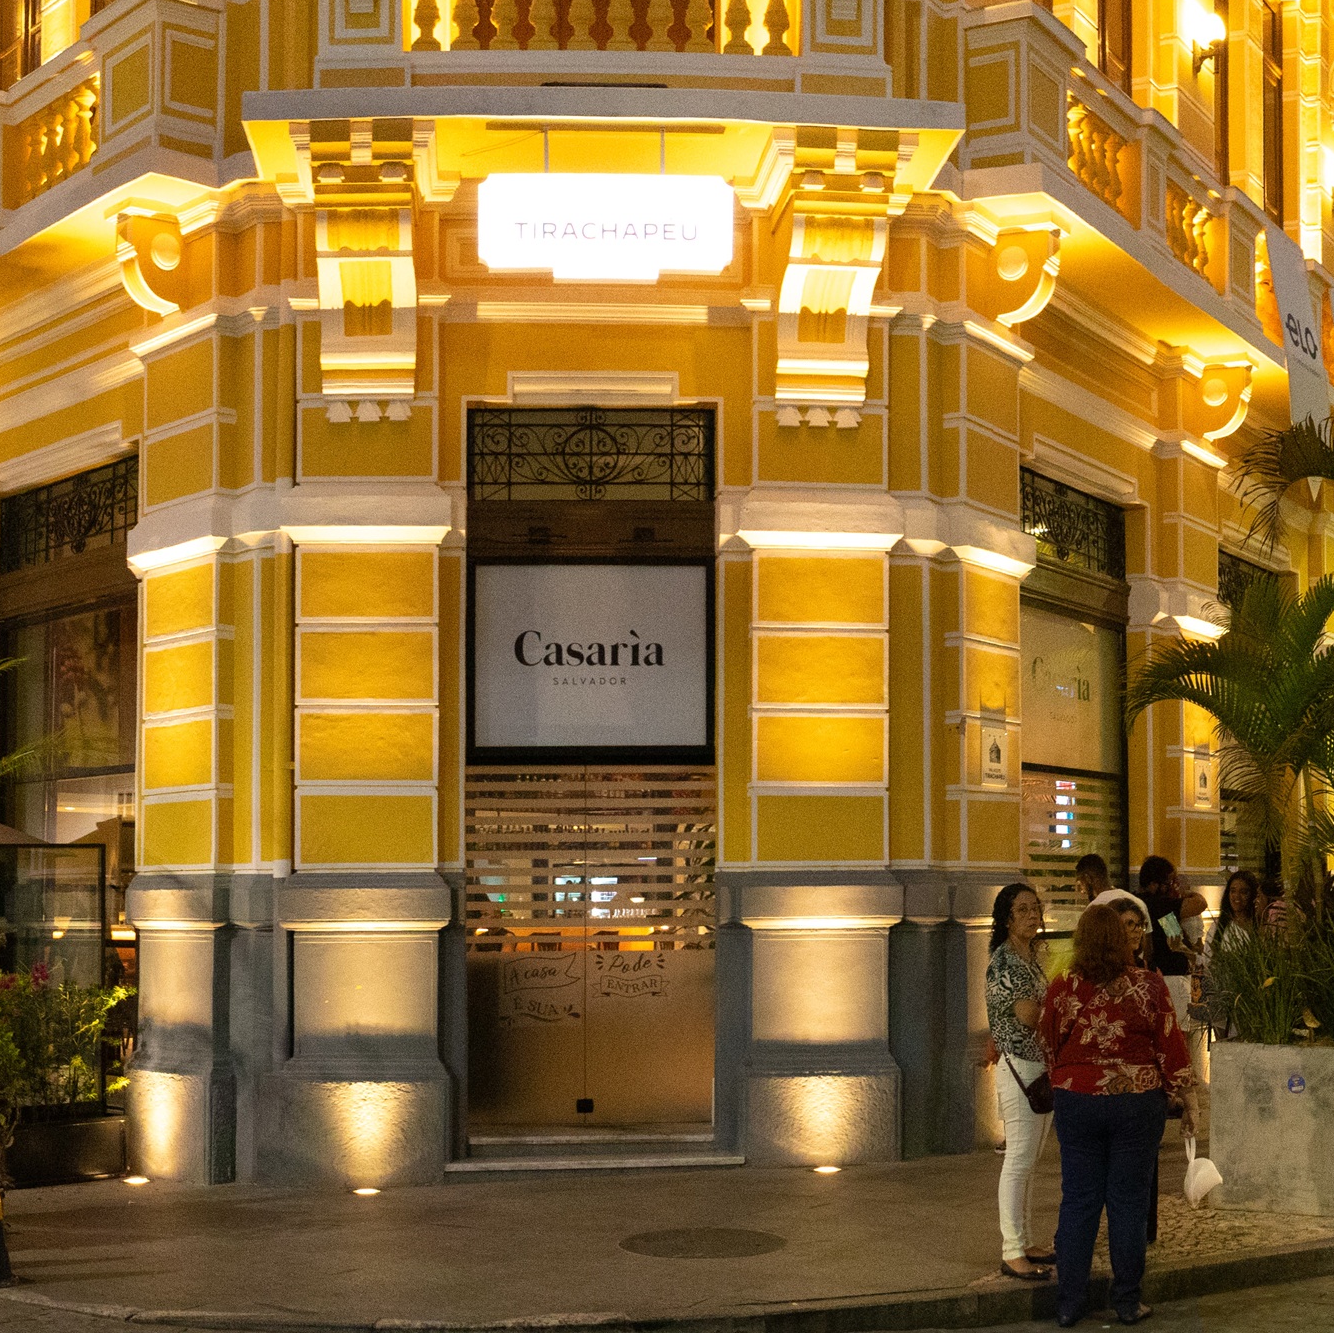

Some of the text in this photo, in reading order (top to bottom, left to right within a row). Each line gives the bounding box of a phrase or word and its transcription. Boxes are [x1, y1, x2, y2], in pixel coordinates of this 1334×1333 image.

[552, 676, 627, 686] SALVADOR
[608, 952, 653, 974] Pode
[523, 965, 560, 980] casa
[606, 978, 658, 994] ENTRAR
[527, 1000, 560, 1016] SUA
